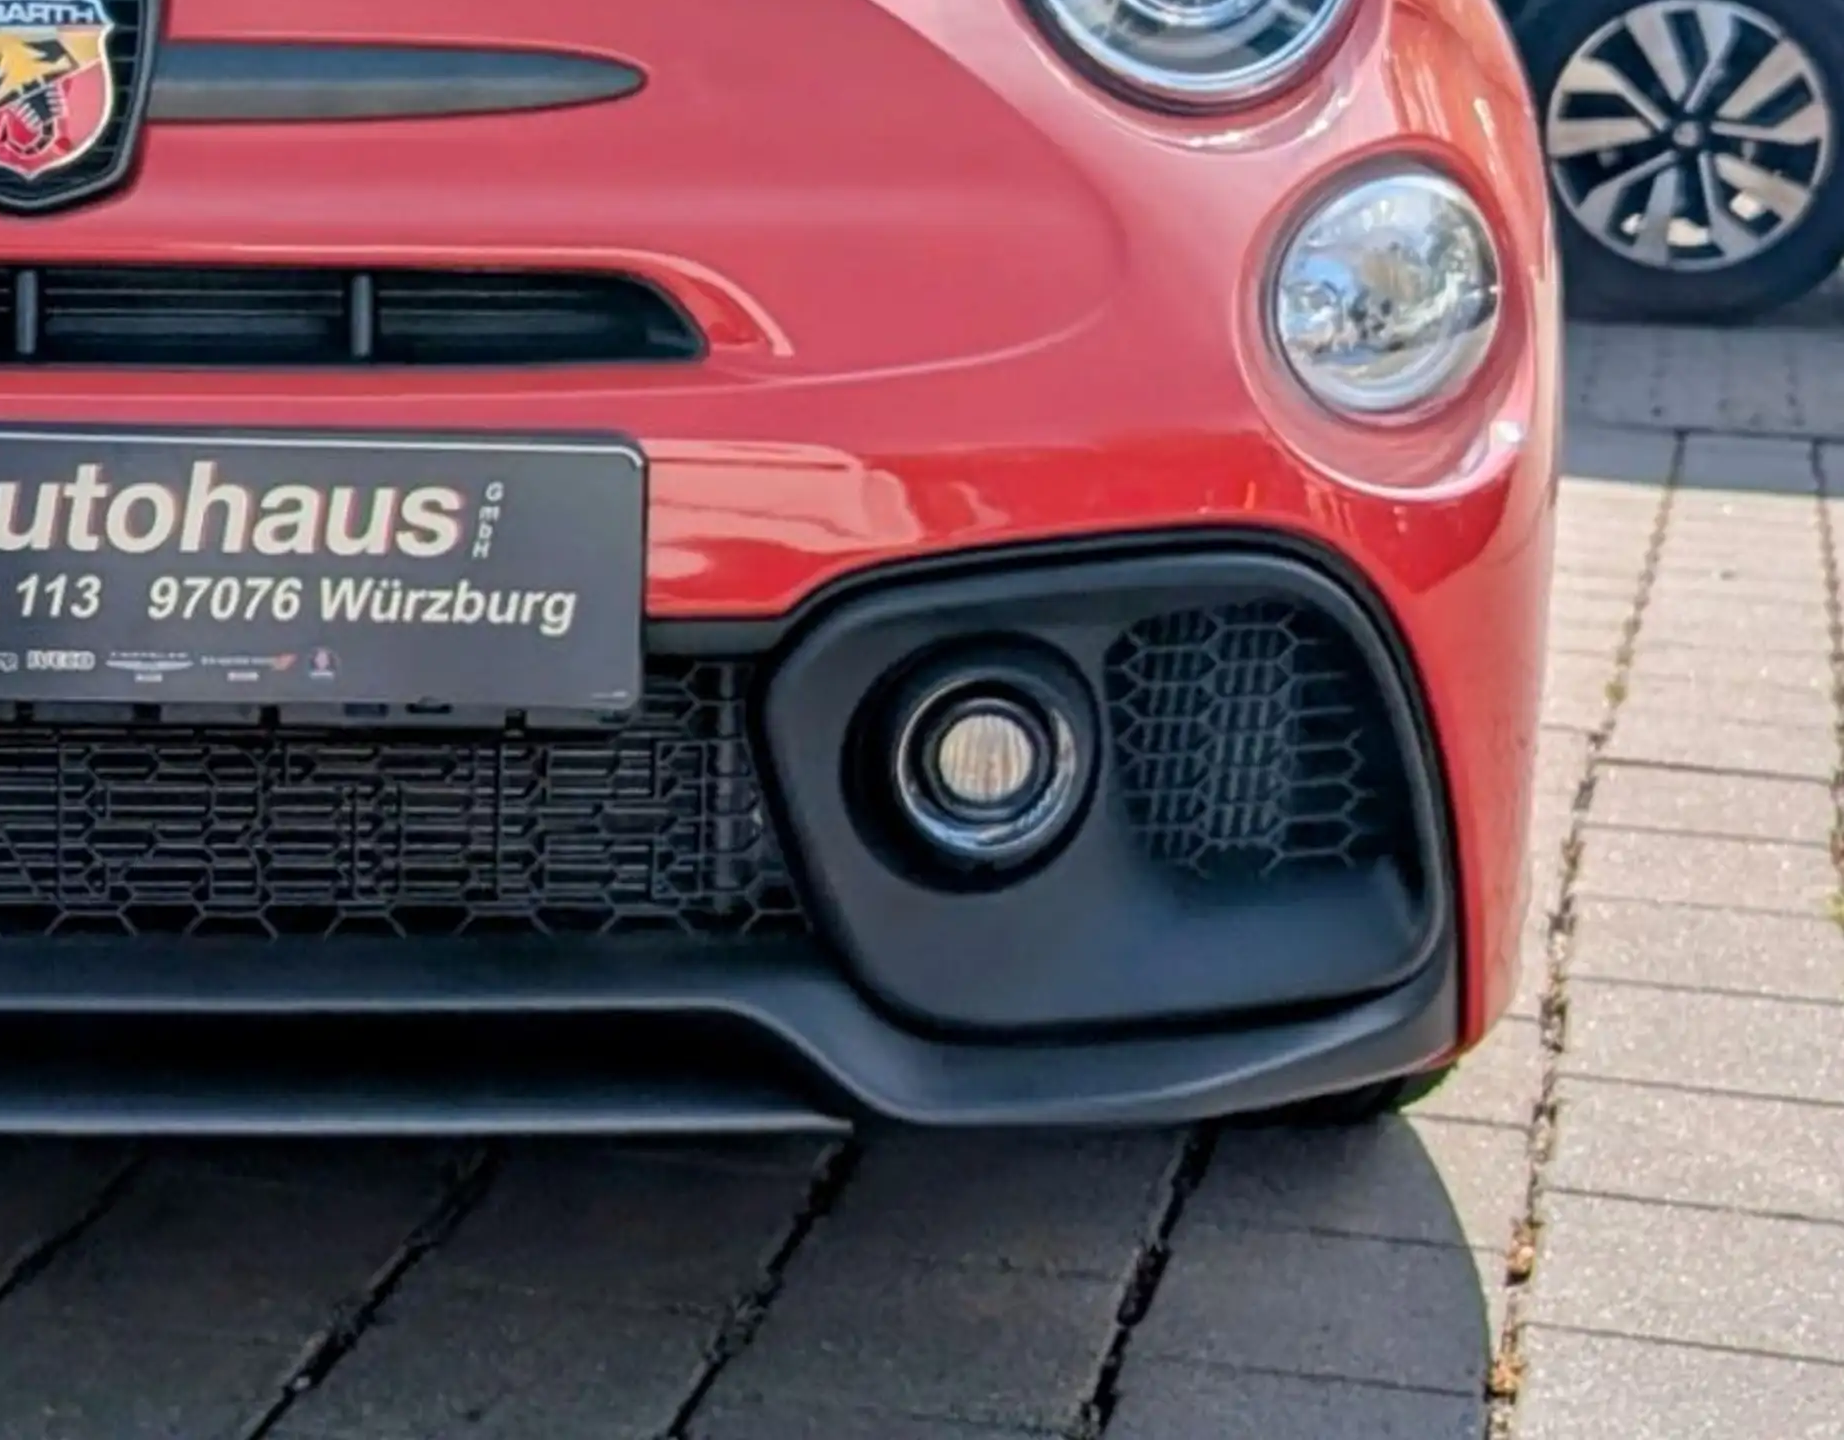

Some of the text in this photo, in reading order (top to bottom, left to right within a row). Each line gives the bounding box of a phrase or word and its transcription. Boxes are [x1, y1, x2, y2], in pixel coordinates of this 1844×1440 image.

[471, 480, 505, 559] GmbH
[14, 573, 102, 620] 113
[147, 575, 304, 622] 97076
[318, 576, 578, 637] Würzburg
[26, 650, 96, 672] IVECO
